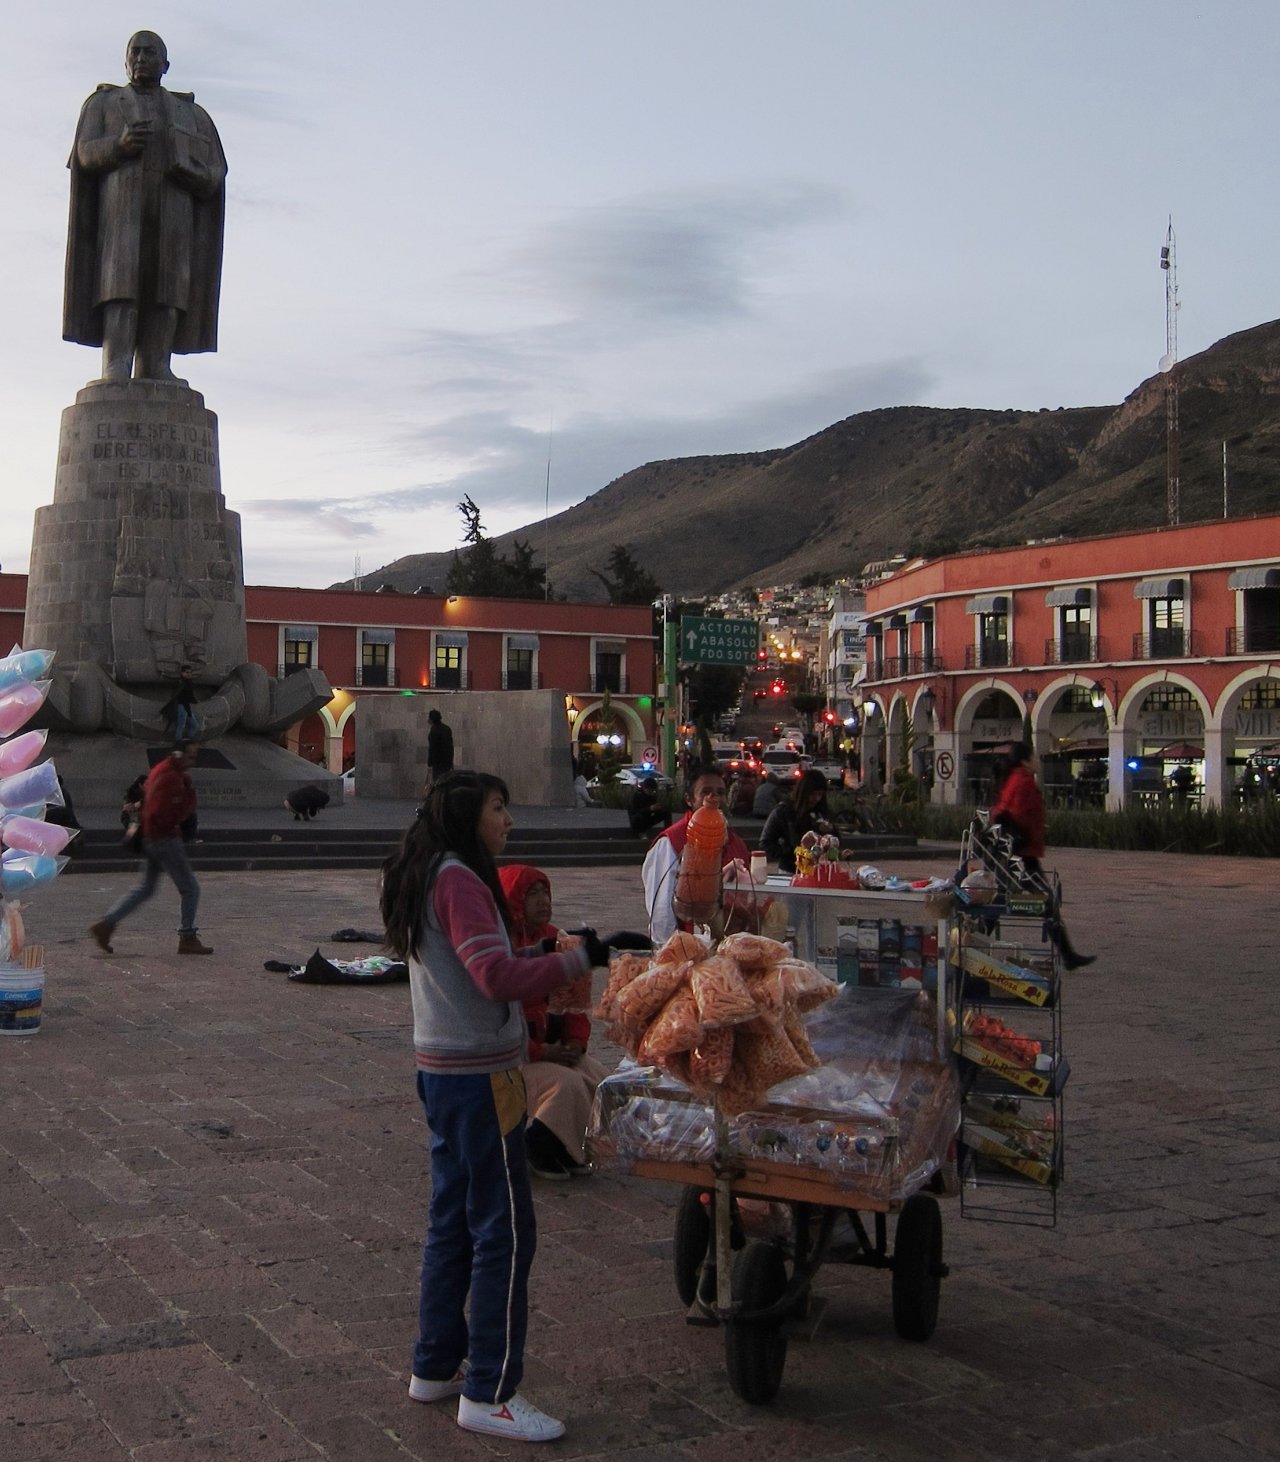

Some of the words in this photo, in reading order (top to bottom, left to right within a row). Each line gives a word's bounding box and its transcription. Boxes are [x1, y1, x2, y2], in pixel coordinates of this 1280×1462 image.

[97, 423, 116, 438] EL
[126, 421, 197, 442] RESPETO
[93, 442, 172, 460] DERECHO
[698, 623, 756, 635] ACTOPAN
[700, 636, 756, 648] ABASOLO
[727, 650, 757, 661] SOTO
[997, 973, 1017, 991] Rosa
